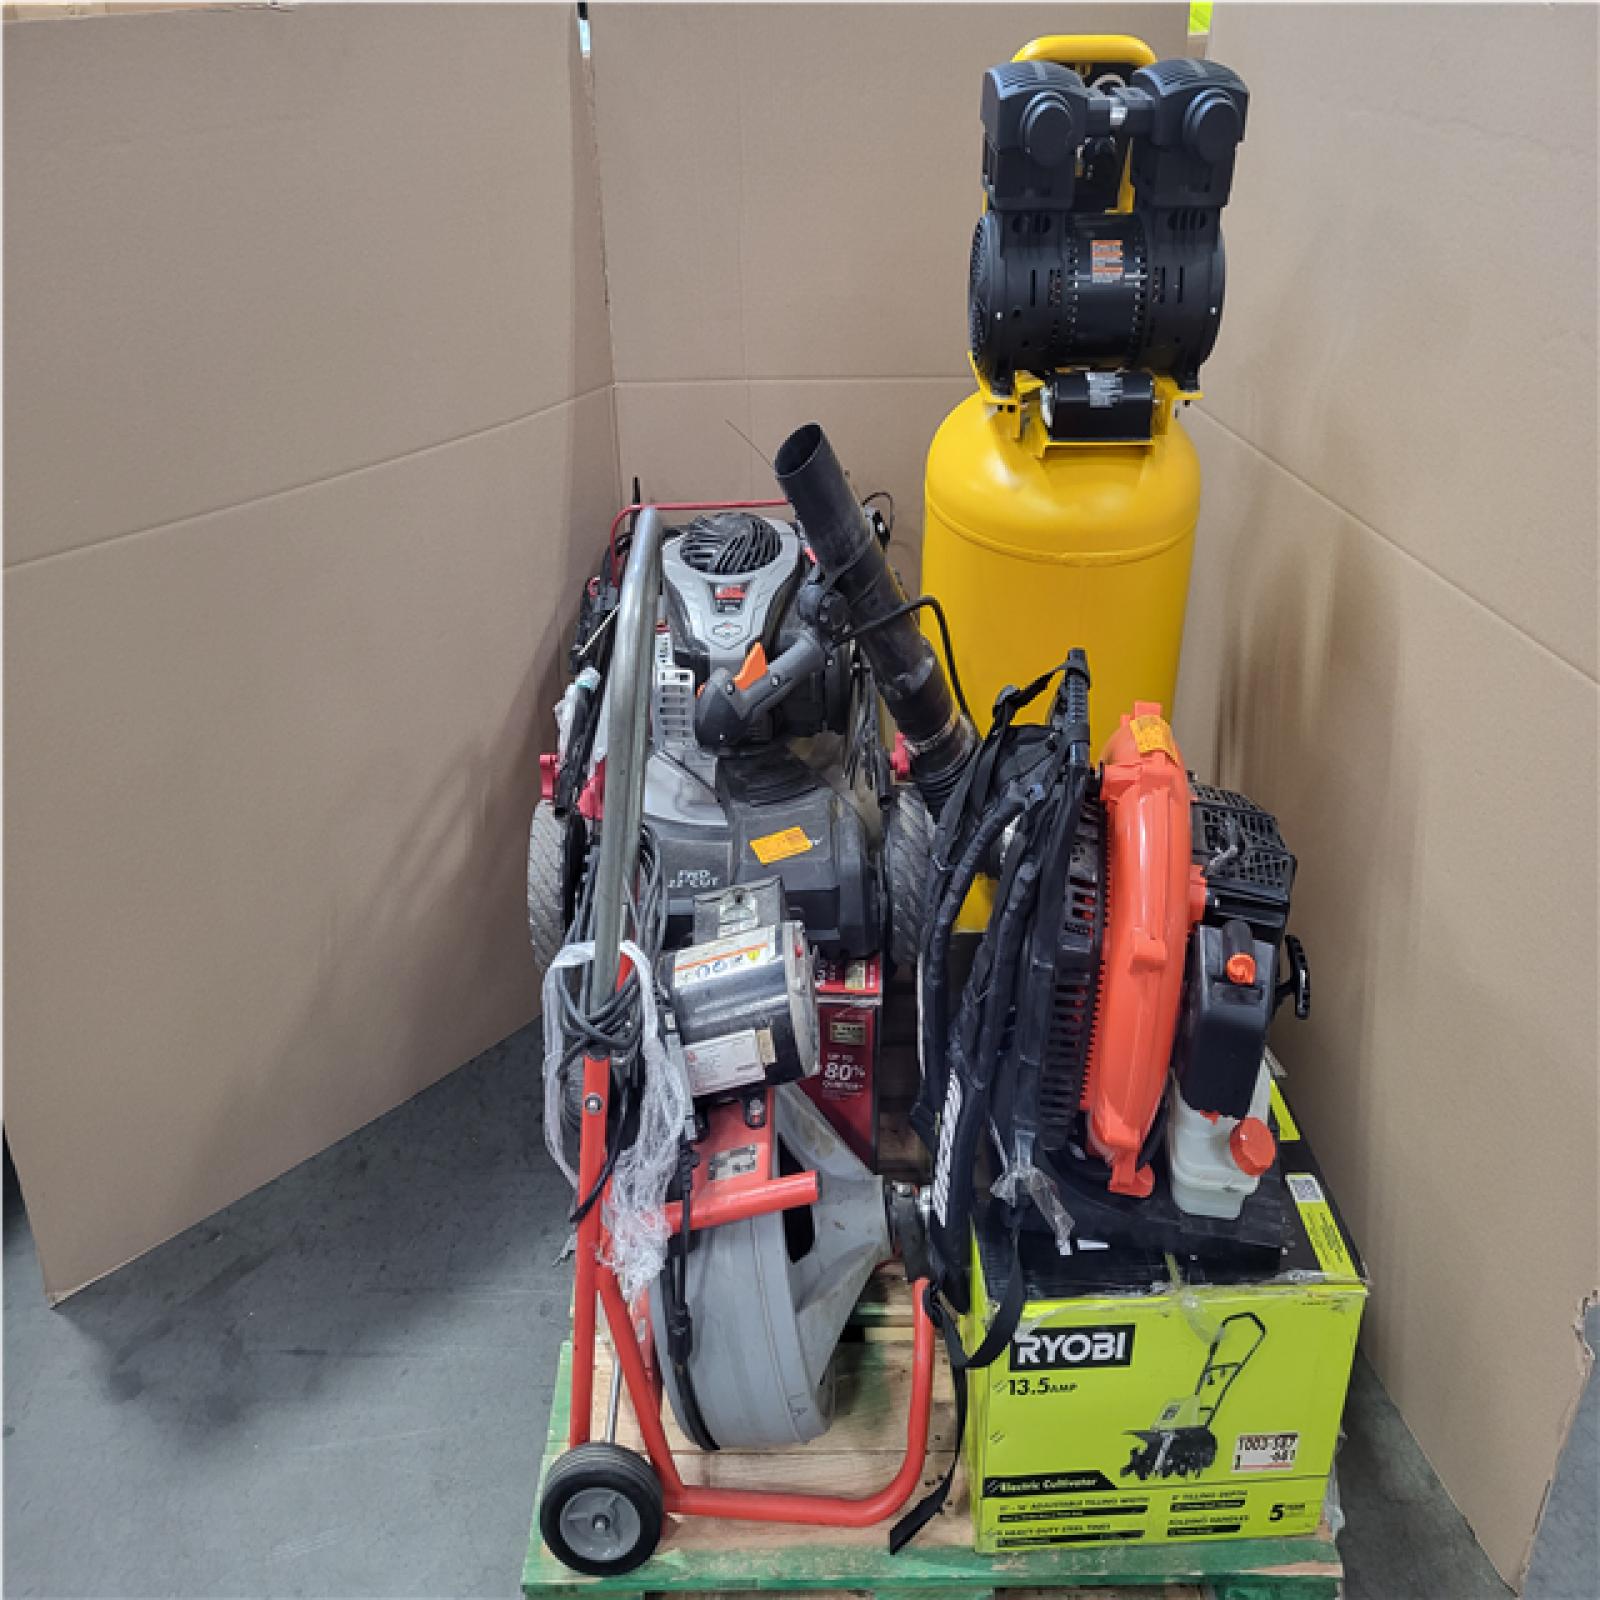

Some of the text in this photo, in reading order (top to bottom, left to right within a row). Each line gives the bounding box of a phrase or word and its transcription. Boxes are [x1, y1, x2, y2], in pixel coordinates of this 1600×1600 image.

[824, 1062, 866, 1081] 80%
[1015, 1331, 1127, 1365] RYOBI
[1269, 1504, 1285, 1522] 5
